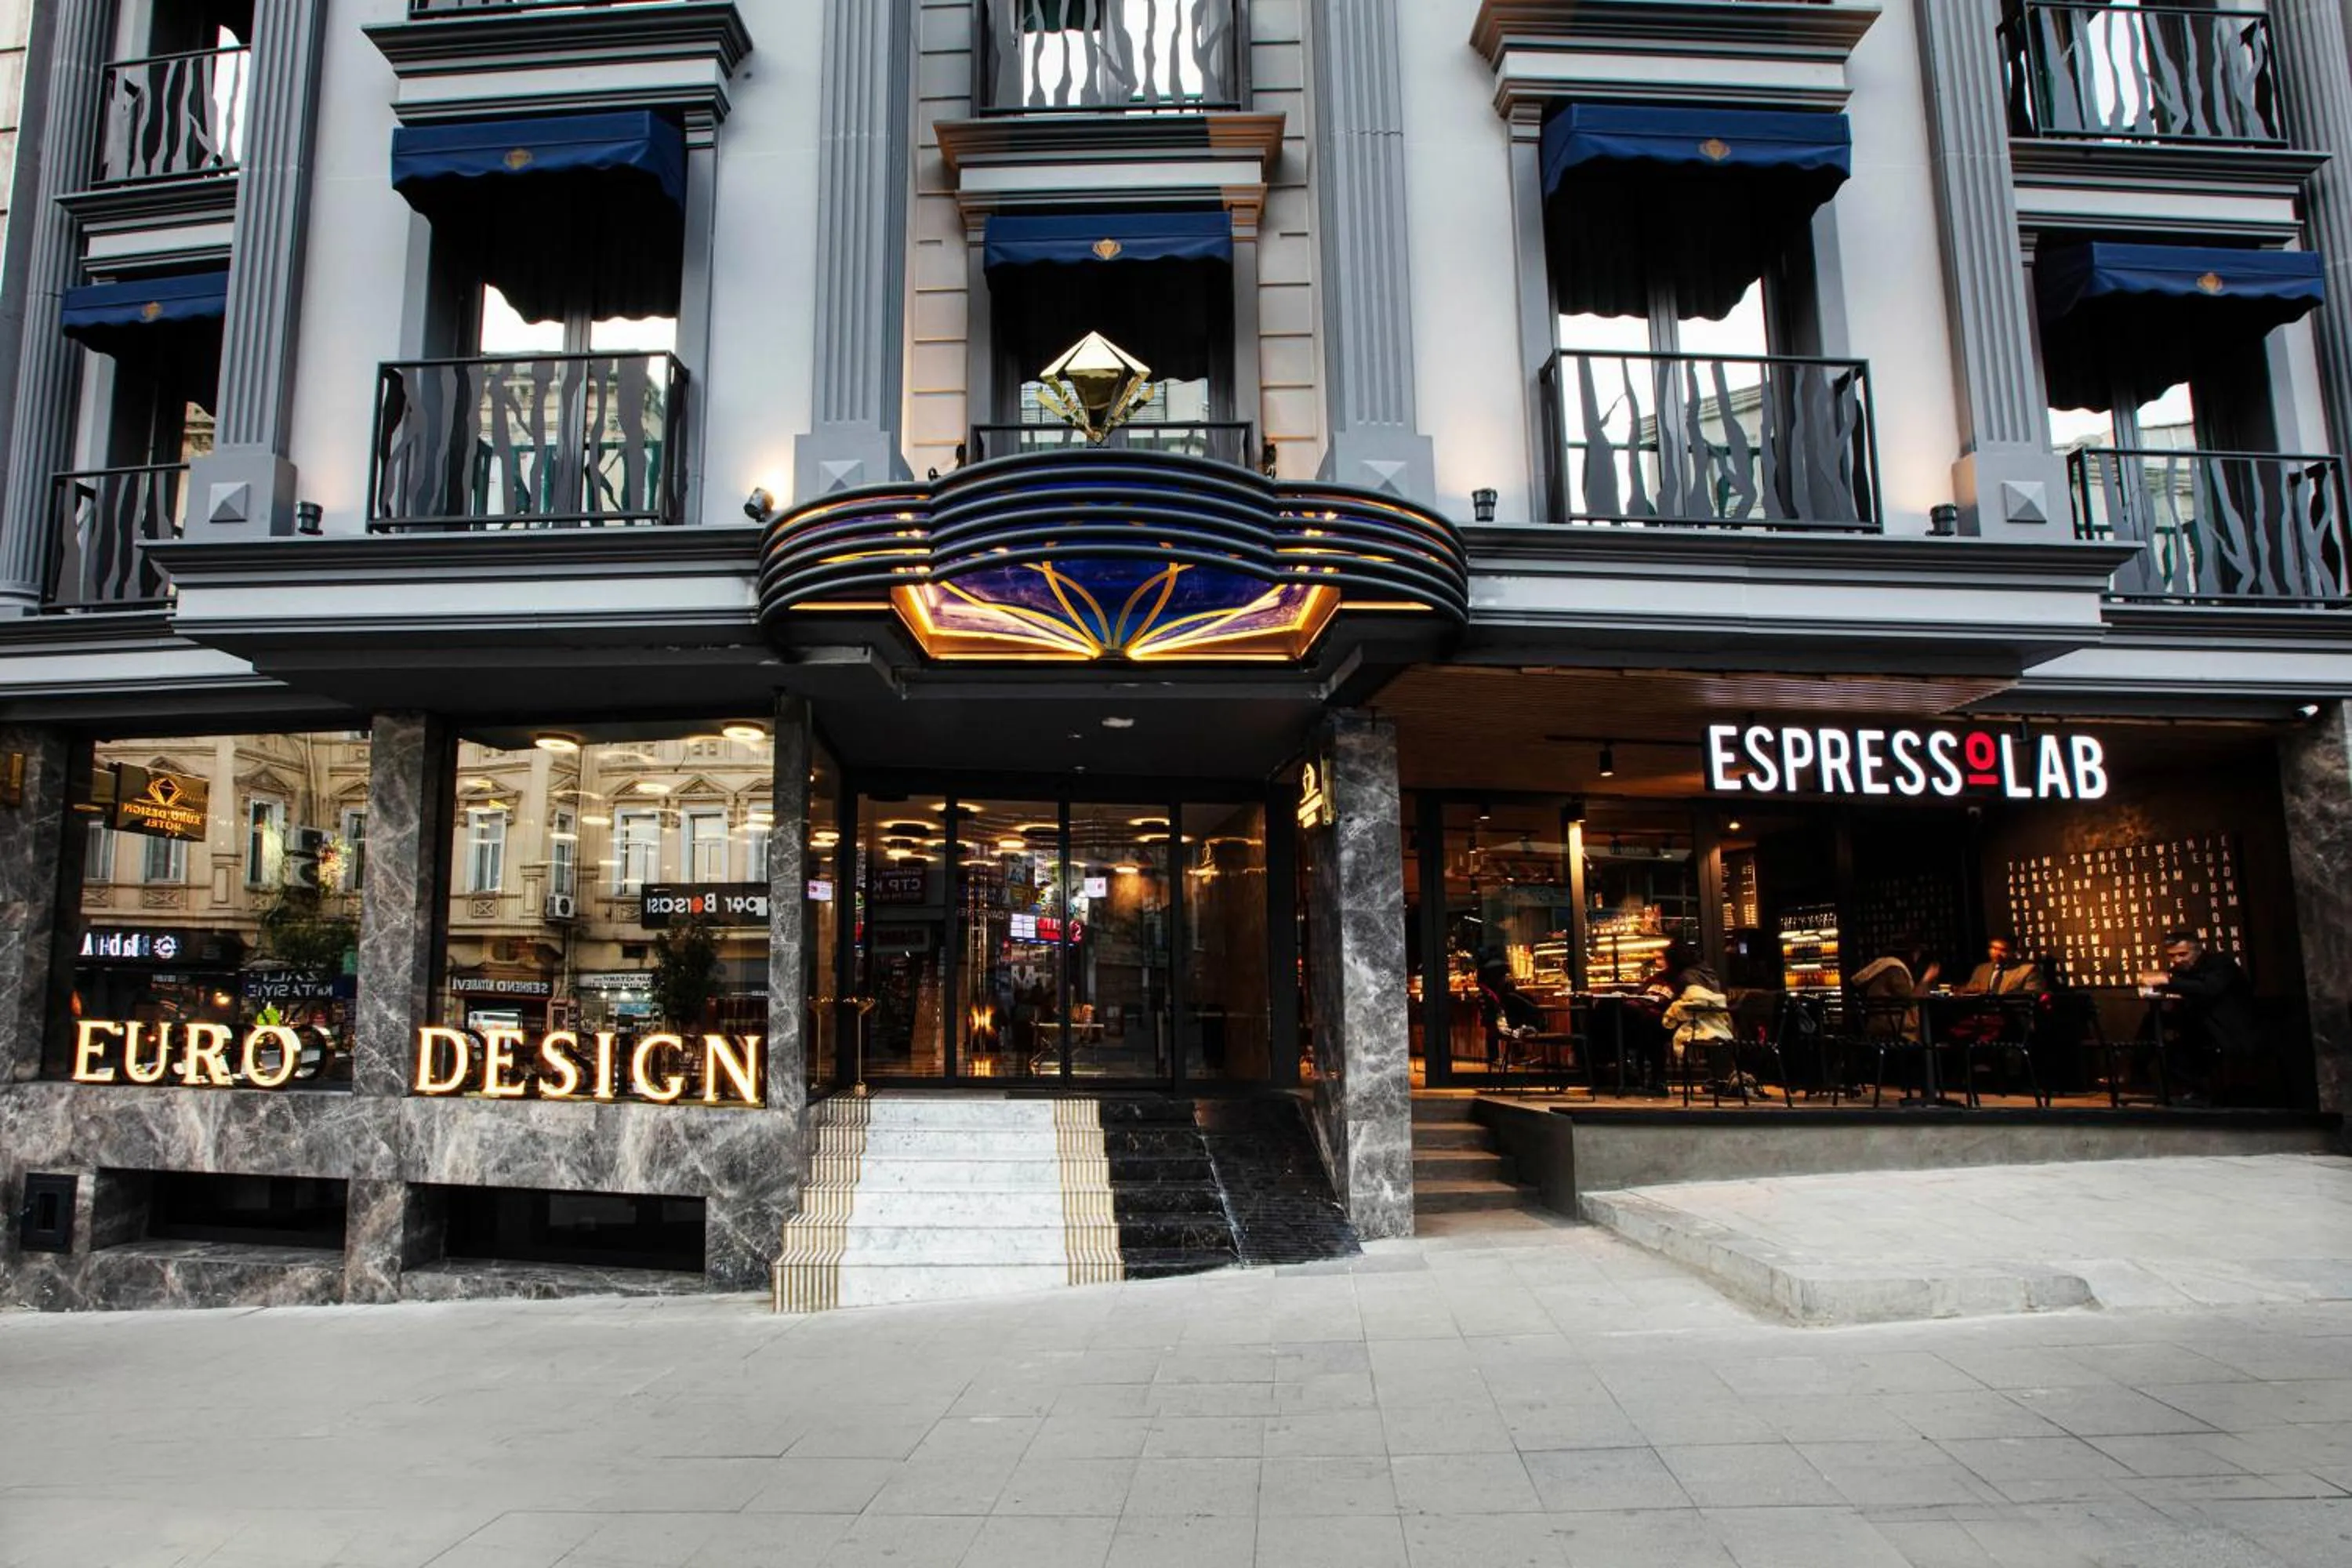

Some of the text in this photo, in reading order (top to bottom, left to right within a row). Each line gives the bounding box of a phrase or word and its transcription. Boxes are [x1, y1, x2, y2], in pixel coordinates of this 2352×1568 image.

[1709, 724, 2108, 800] ESPRESSOLAB
[72, 1020, 761, 1103] EURO DESIGN
